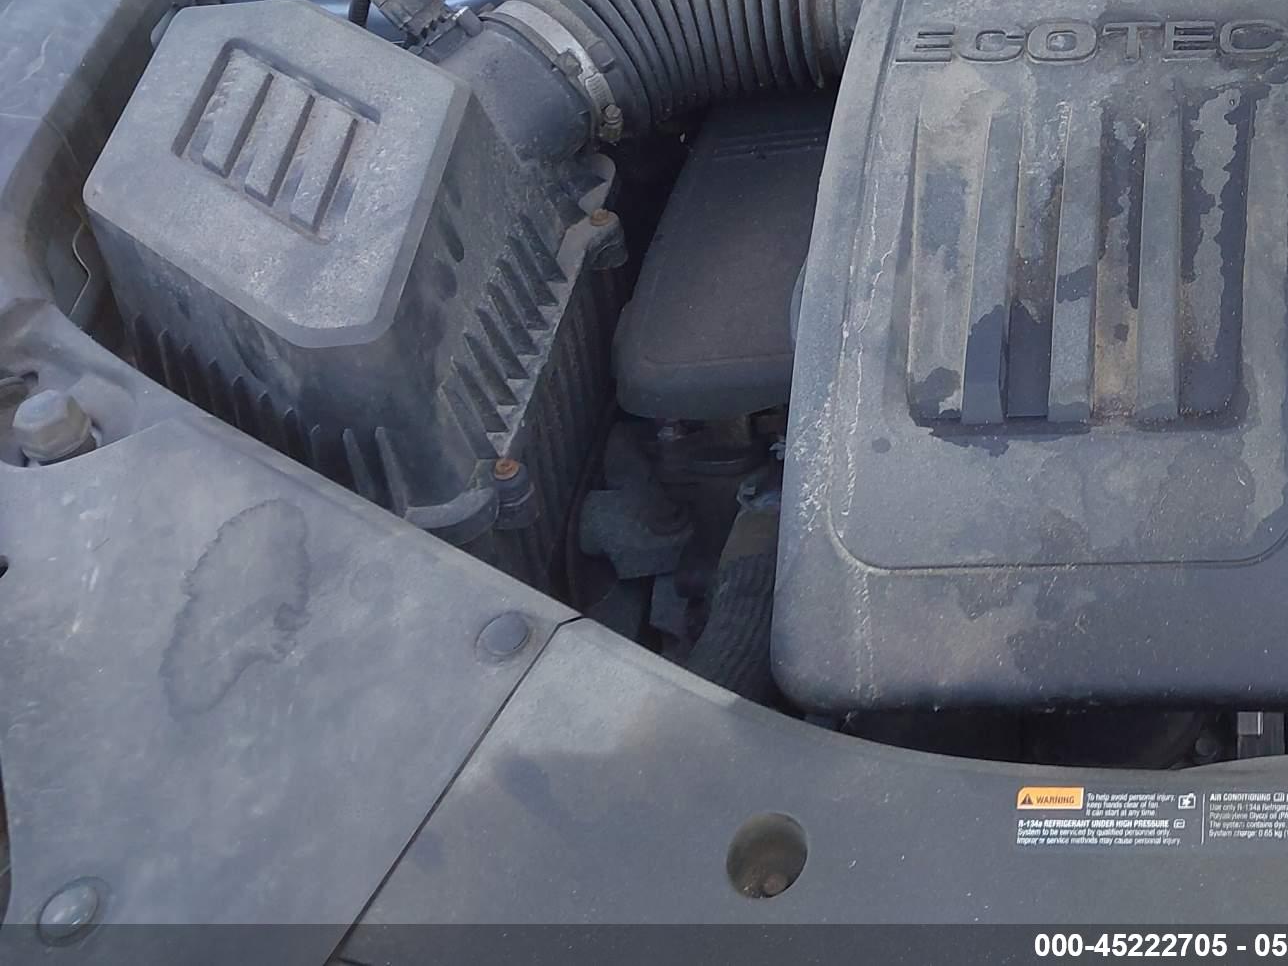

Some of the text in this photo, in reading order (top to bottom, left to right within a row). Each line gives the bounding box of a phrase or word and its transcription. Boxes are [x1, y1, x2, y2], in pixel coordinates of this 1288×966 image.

[894, 19, 1288, 63] ECOTEC
[1036, 795, 1074, 803] WARNING
[1209, 793, 1271, 801] AIR CONDITIONING
[1018, 820, 1169, 828] R-134a REFRIGERANT UNDER HIGH PRESSURE
[1018, 828, 1041, 837] System
[1042, 828, 1049, 837] to
[1050, 828, 1058, 837] be
[1087, 828, 1095, 837] by
